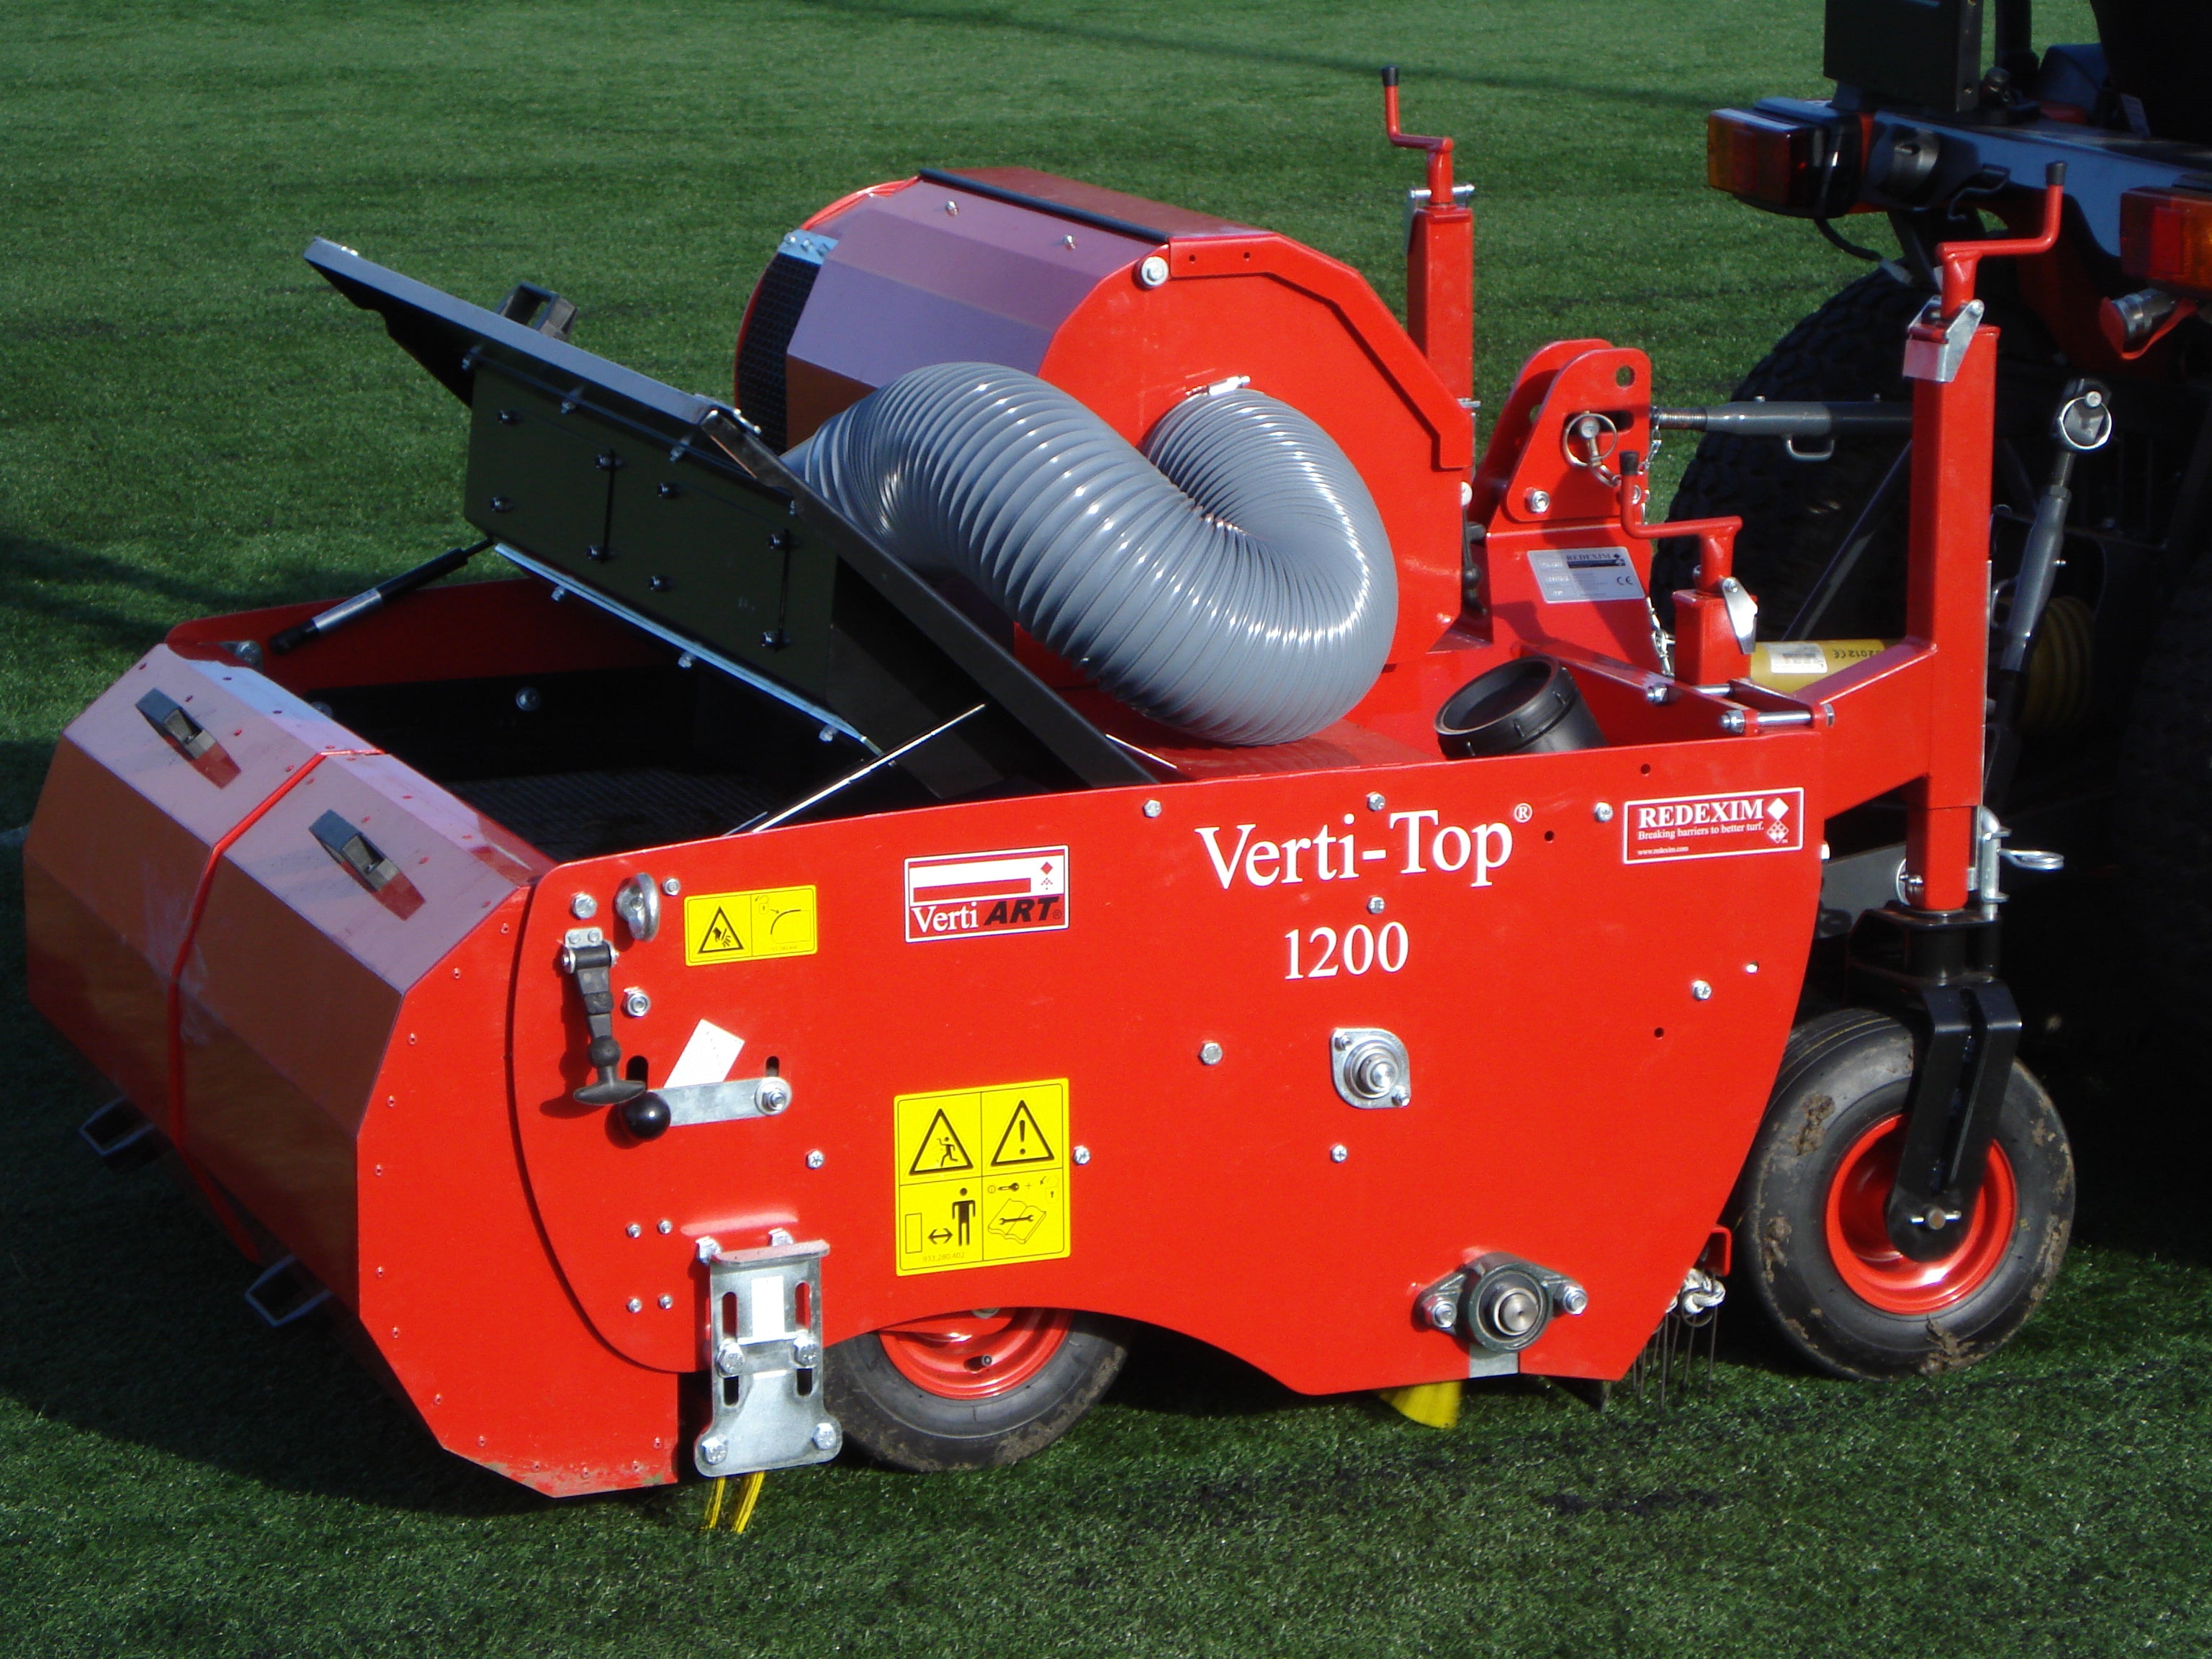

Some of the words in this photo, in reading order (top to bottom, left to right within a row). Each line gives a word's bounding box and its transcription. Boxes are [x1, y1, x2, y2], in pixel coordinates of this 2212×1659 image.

[1638, 799, 1764, 829] REDEXIM
[1637, 830, 1676, 841] Breaking
[1677, 826, 1709, 838] barriers
[1710, 825, 1719, 835] to
[1721, 823, 1745, 834] better
[1746, 822, 1764, 831] turf.
[1637, 845, 1689, 855] www.redexim.com
[911, 901, 979, 933] Verti
[1285, 921, 1409, 980] 1200
